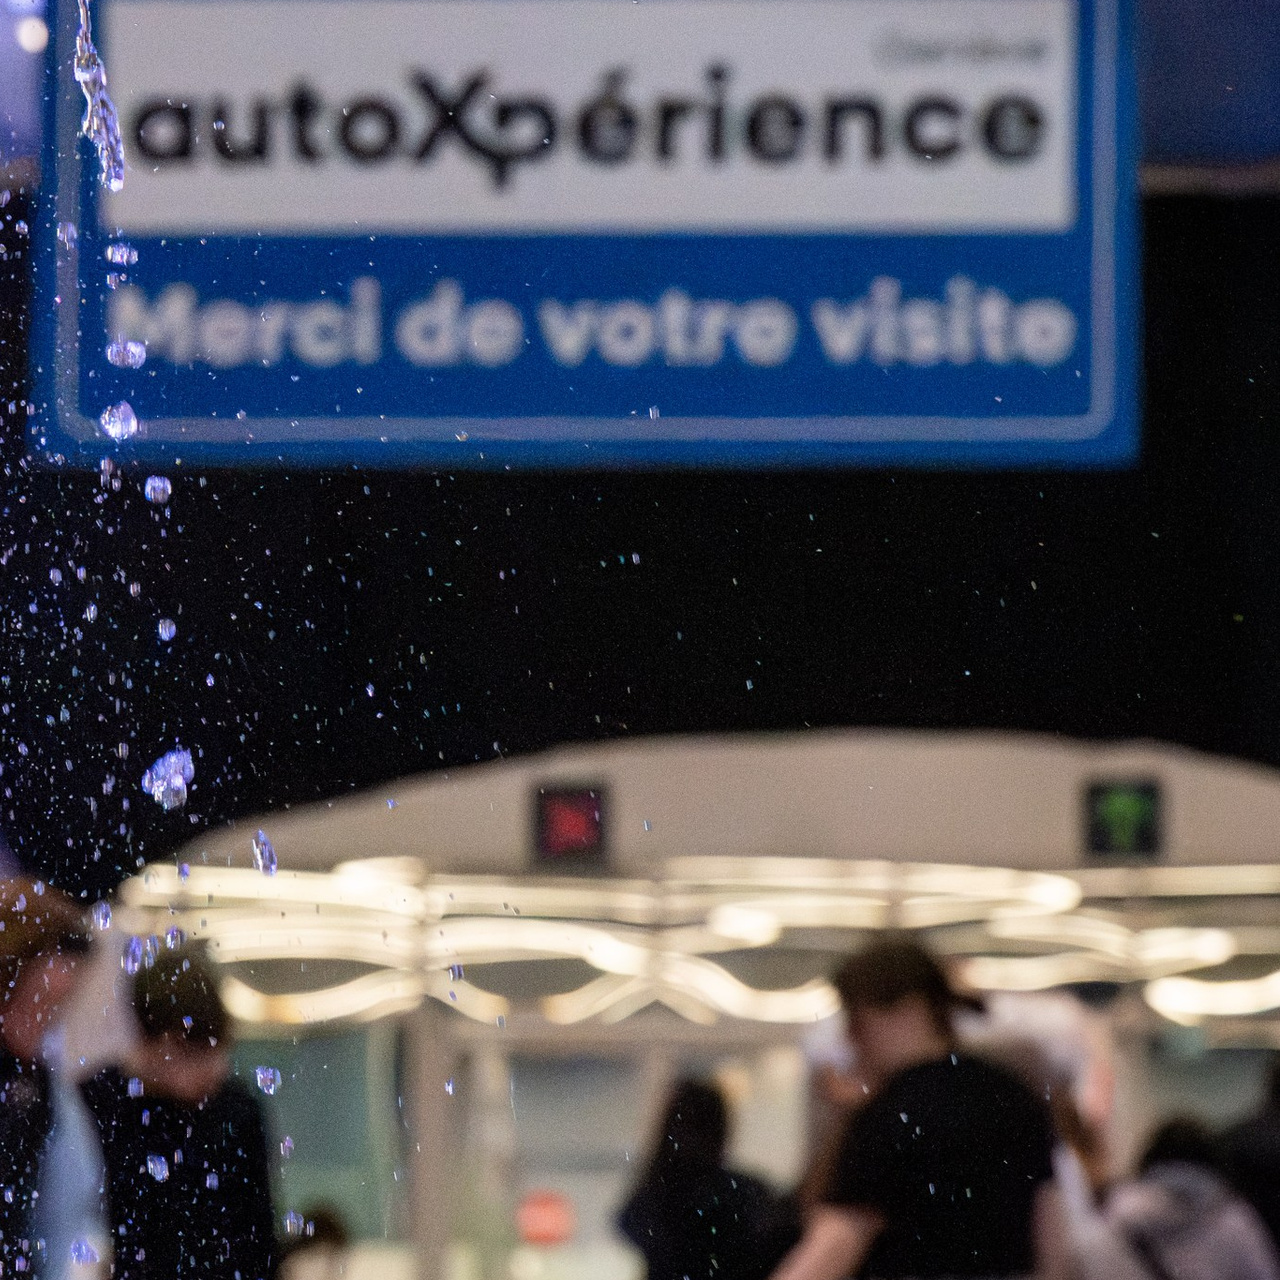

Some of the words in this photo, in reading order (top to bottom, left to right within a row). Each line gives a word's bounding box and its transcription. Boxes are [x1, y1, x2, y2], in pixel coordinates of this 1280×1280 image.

[134, 67, 1046, 188] autoXpérience
[108, 282, 381, 366] Merci
[396, 279, 521, 367] de
[539, 287, 797, 367] votre
[815, 276, 1076, 367] visite
